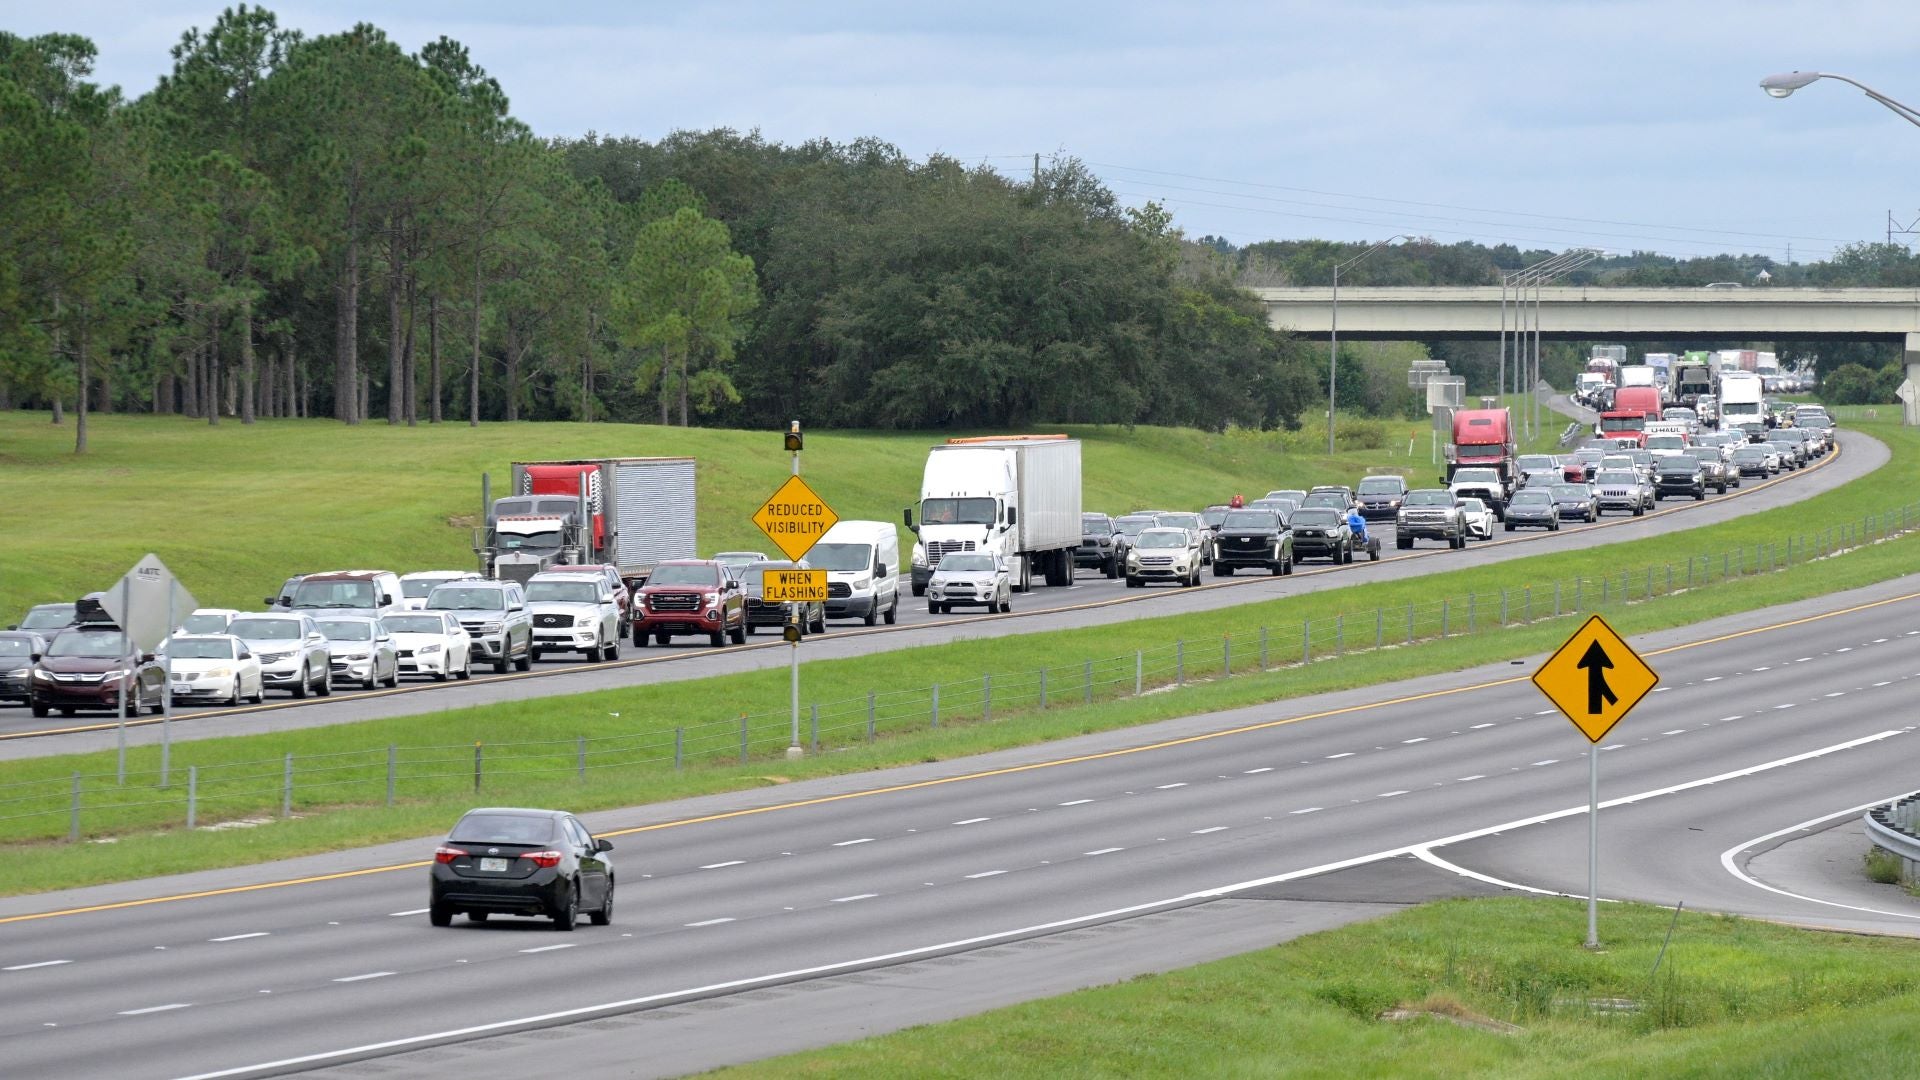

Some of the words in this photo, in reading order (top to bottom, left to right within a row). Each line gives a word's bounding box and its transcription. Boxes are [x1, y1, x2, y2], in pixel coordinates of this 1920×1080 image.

[768, 504, 822, 516] REDUCED
[766, 522, 825, 534] VISIBILITY
[779, 572, 812, 585] WHEN
[766, 586, 824, 599] FLASHING
